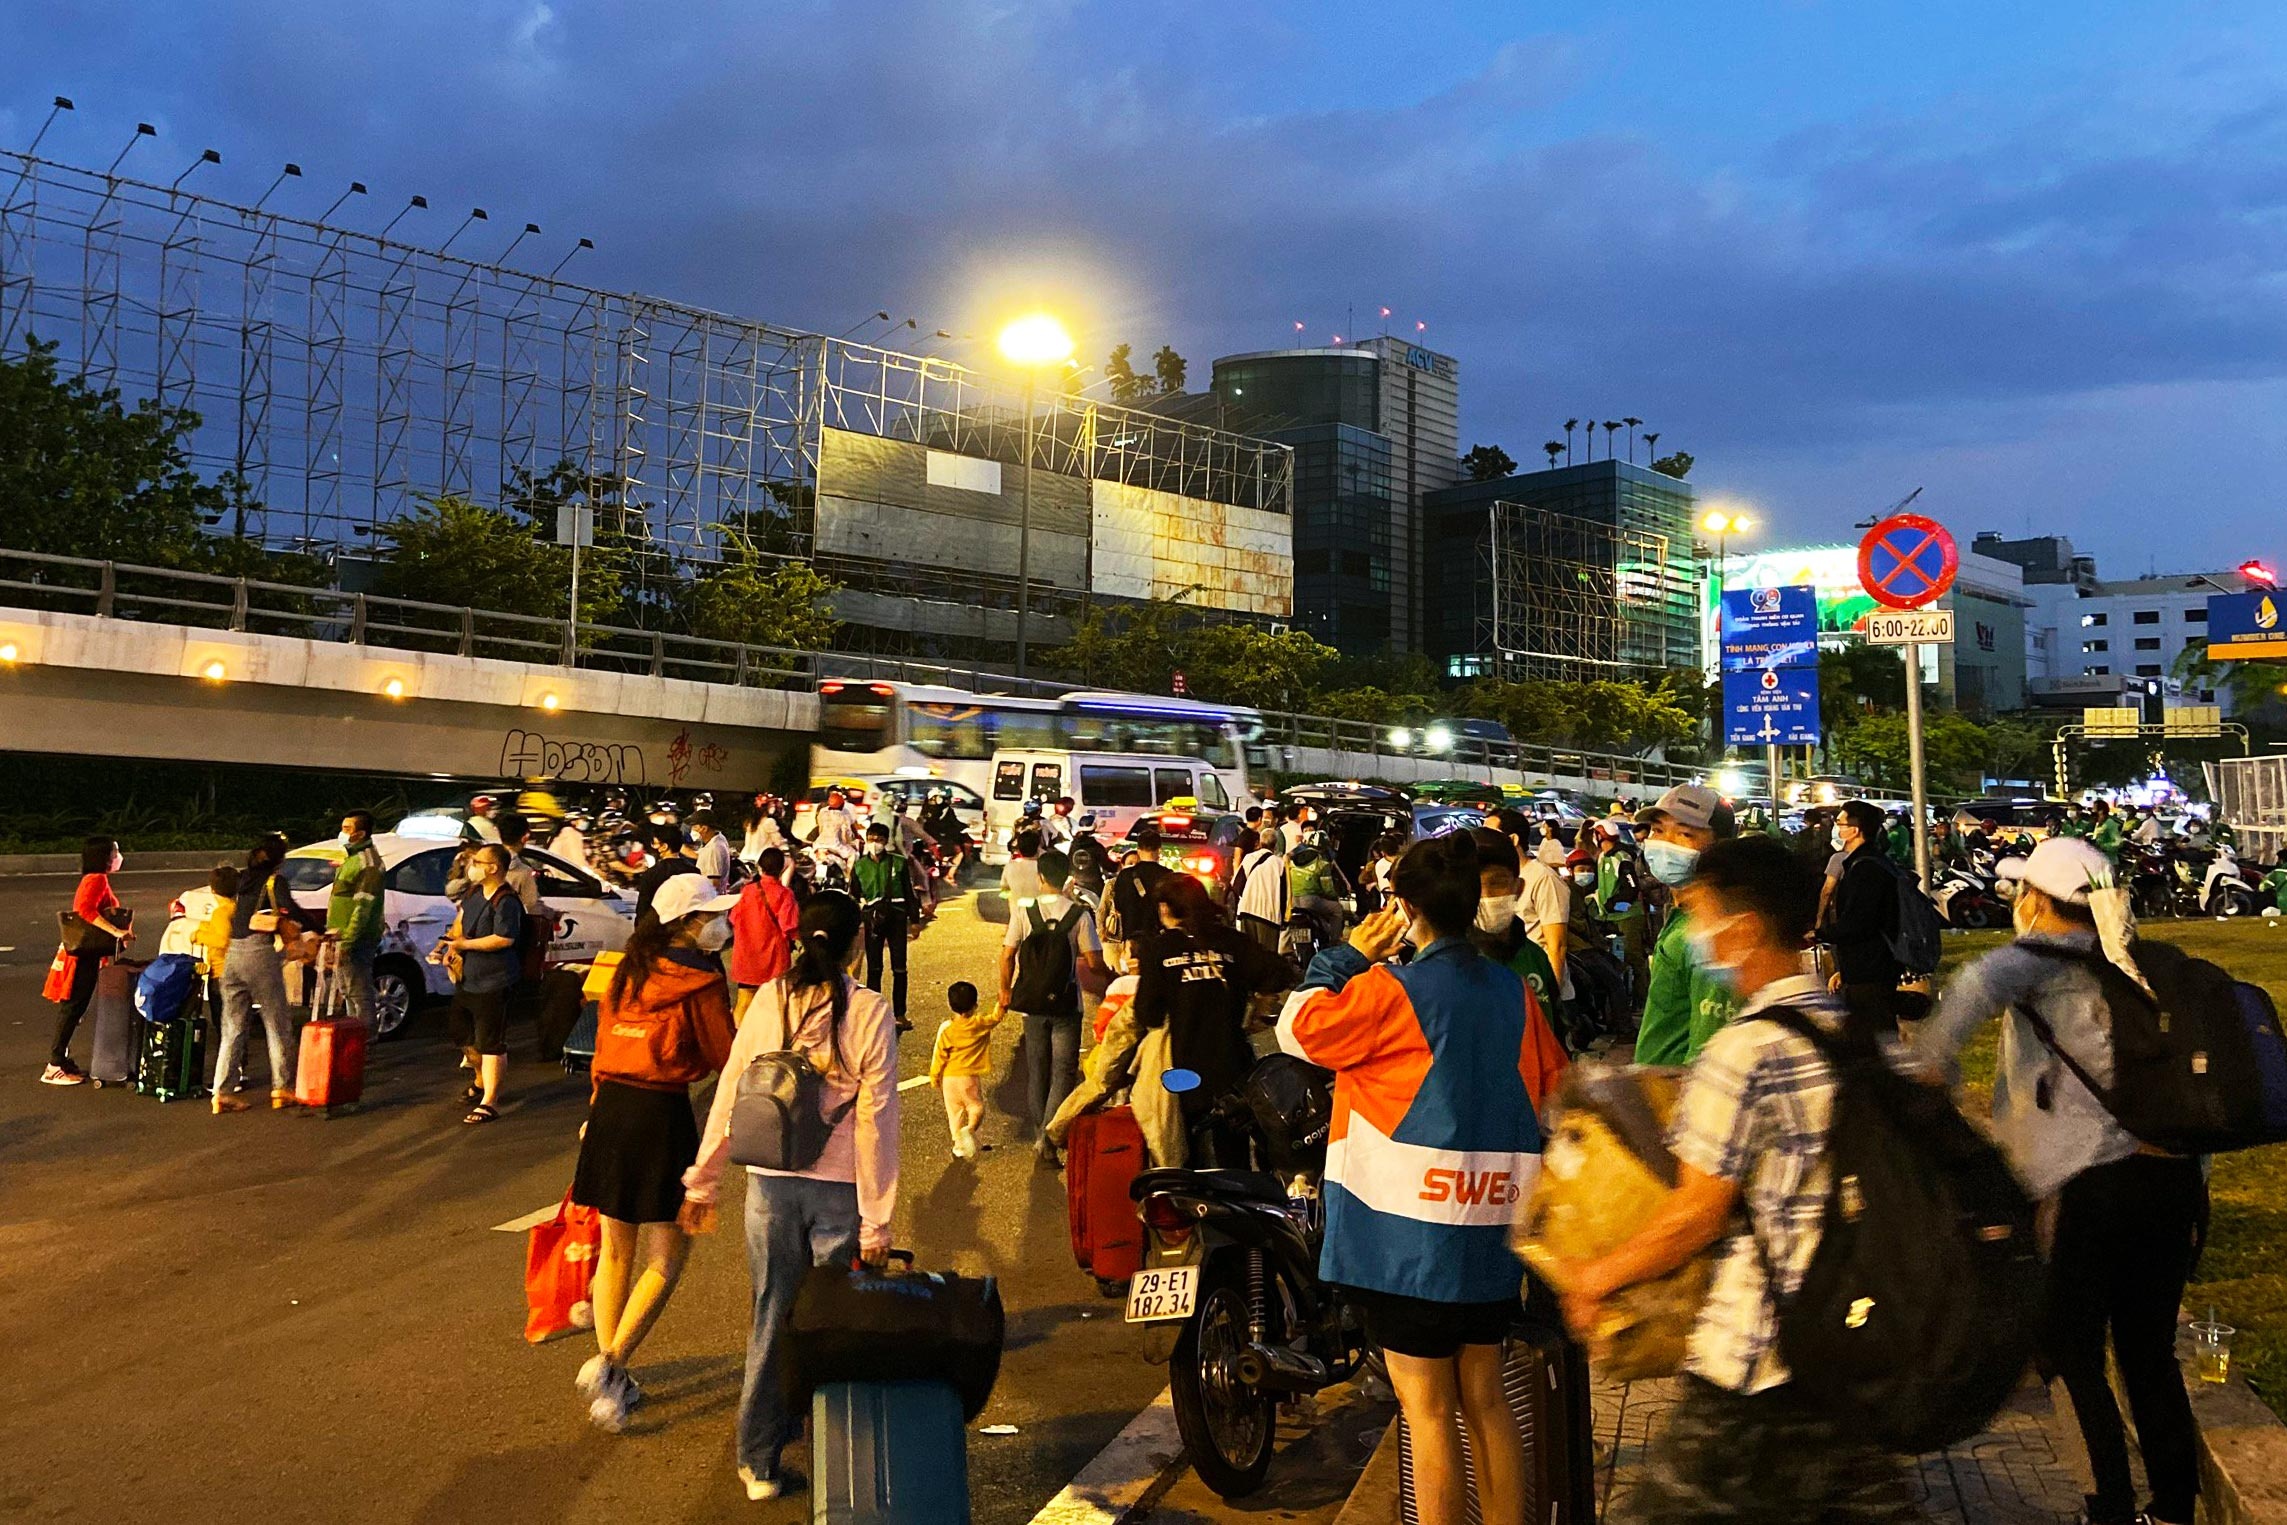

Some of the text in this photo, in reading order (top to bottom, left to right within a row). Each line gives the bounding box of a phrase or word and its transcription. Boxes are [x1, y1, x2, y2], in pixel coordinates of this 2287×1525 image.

[1406, 347, 1433, 372] ACV
[1140, 1271, 1188, 1294] 29-E1
[1133, 1293, 1189, 1318] 182.34
